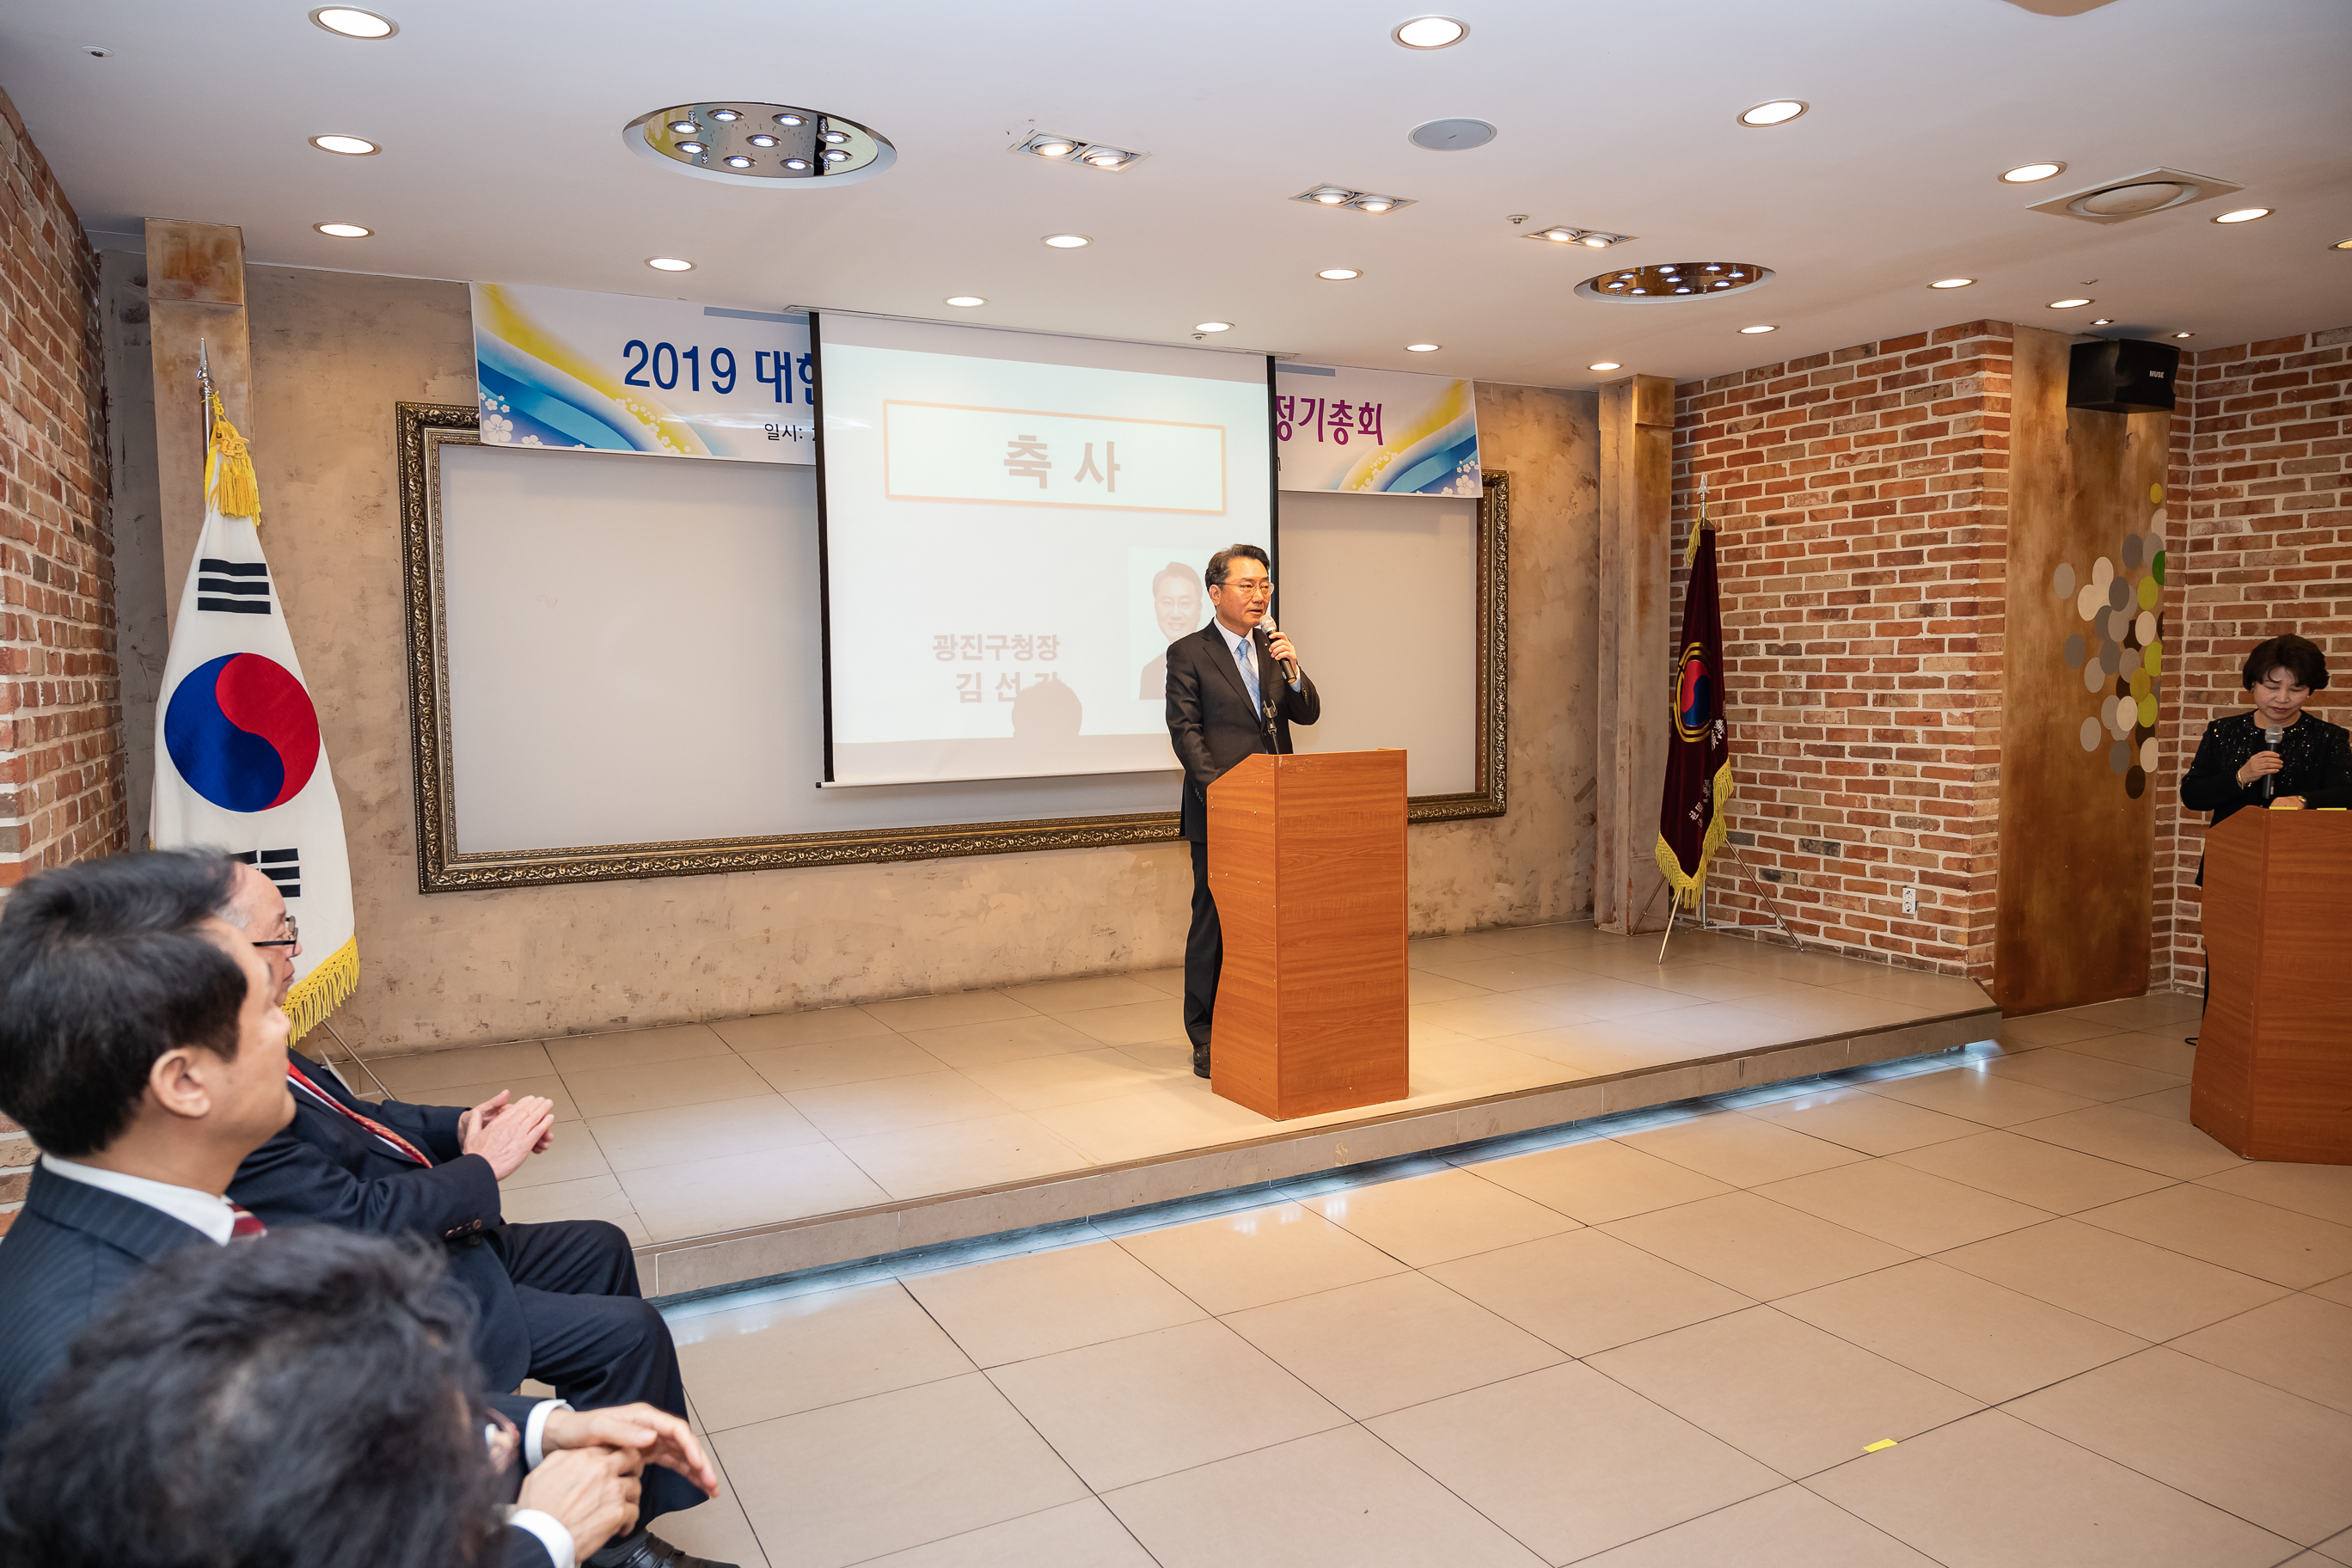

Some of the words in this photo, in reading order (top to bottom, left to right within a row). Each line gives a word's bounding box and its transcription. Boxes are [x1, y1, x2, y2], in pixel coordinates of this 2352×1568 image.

[622, 339, 737, 395] 2019
[2149, 370, 2165, 378] MUSE
[764, 423, 804, 443] 일시:
[1276, 395, 1384, 446] 정기총회
[933, 634, 1060, 662] 광진구청장
